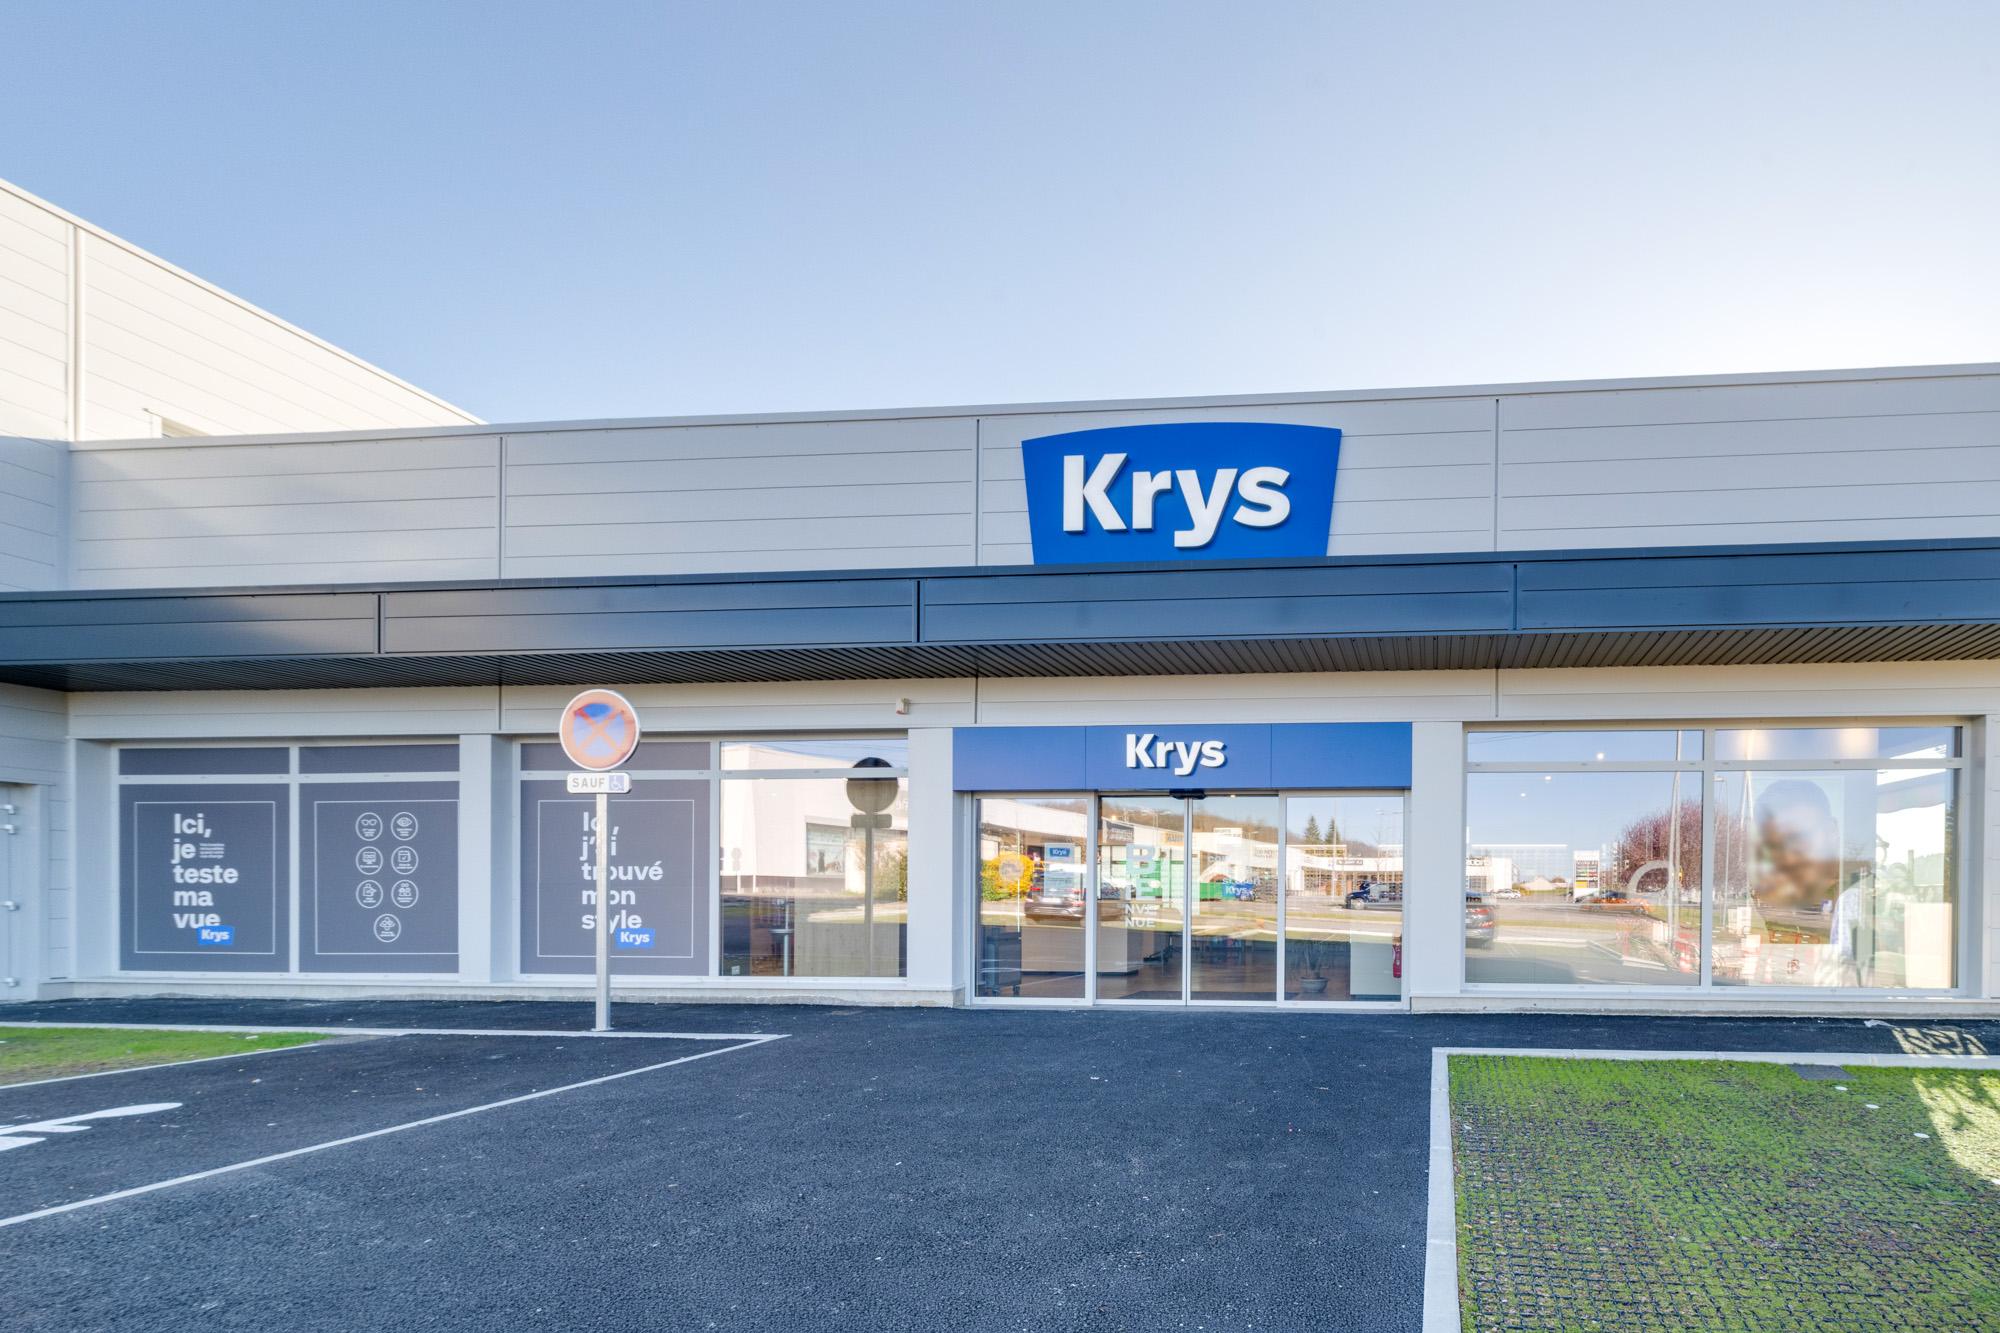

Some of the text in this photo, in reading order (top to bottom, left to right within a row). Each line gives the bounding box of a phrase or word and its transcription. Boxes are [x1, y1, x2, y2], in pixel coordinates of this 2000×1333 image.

[1063, 453, 1291, 548] Krys
[1126, 733, 1226, 775] Krys
[572, 777, 605, 788] SAUF
[174, 813, 212, 838] Ici,
[583, 811, 620, 835] Ic,
[171, 838, 196, 864] je
[579, 836, 617, 861] j'i
[173, 865, 239, 883] teste
[173, 890, 214, 906] ma
[173, 913, 221, 928] vue
[581, 909, 642, 934] syle
[201, 929, 230, 942] Krys
[620, 931, 650, 945] Krys
